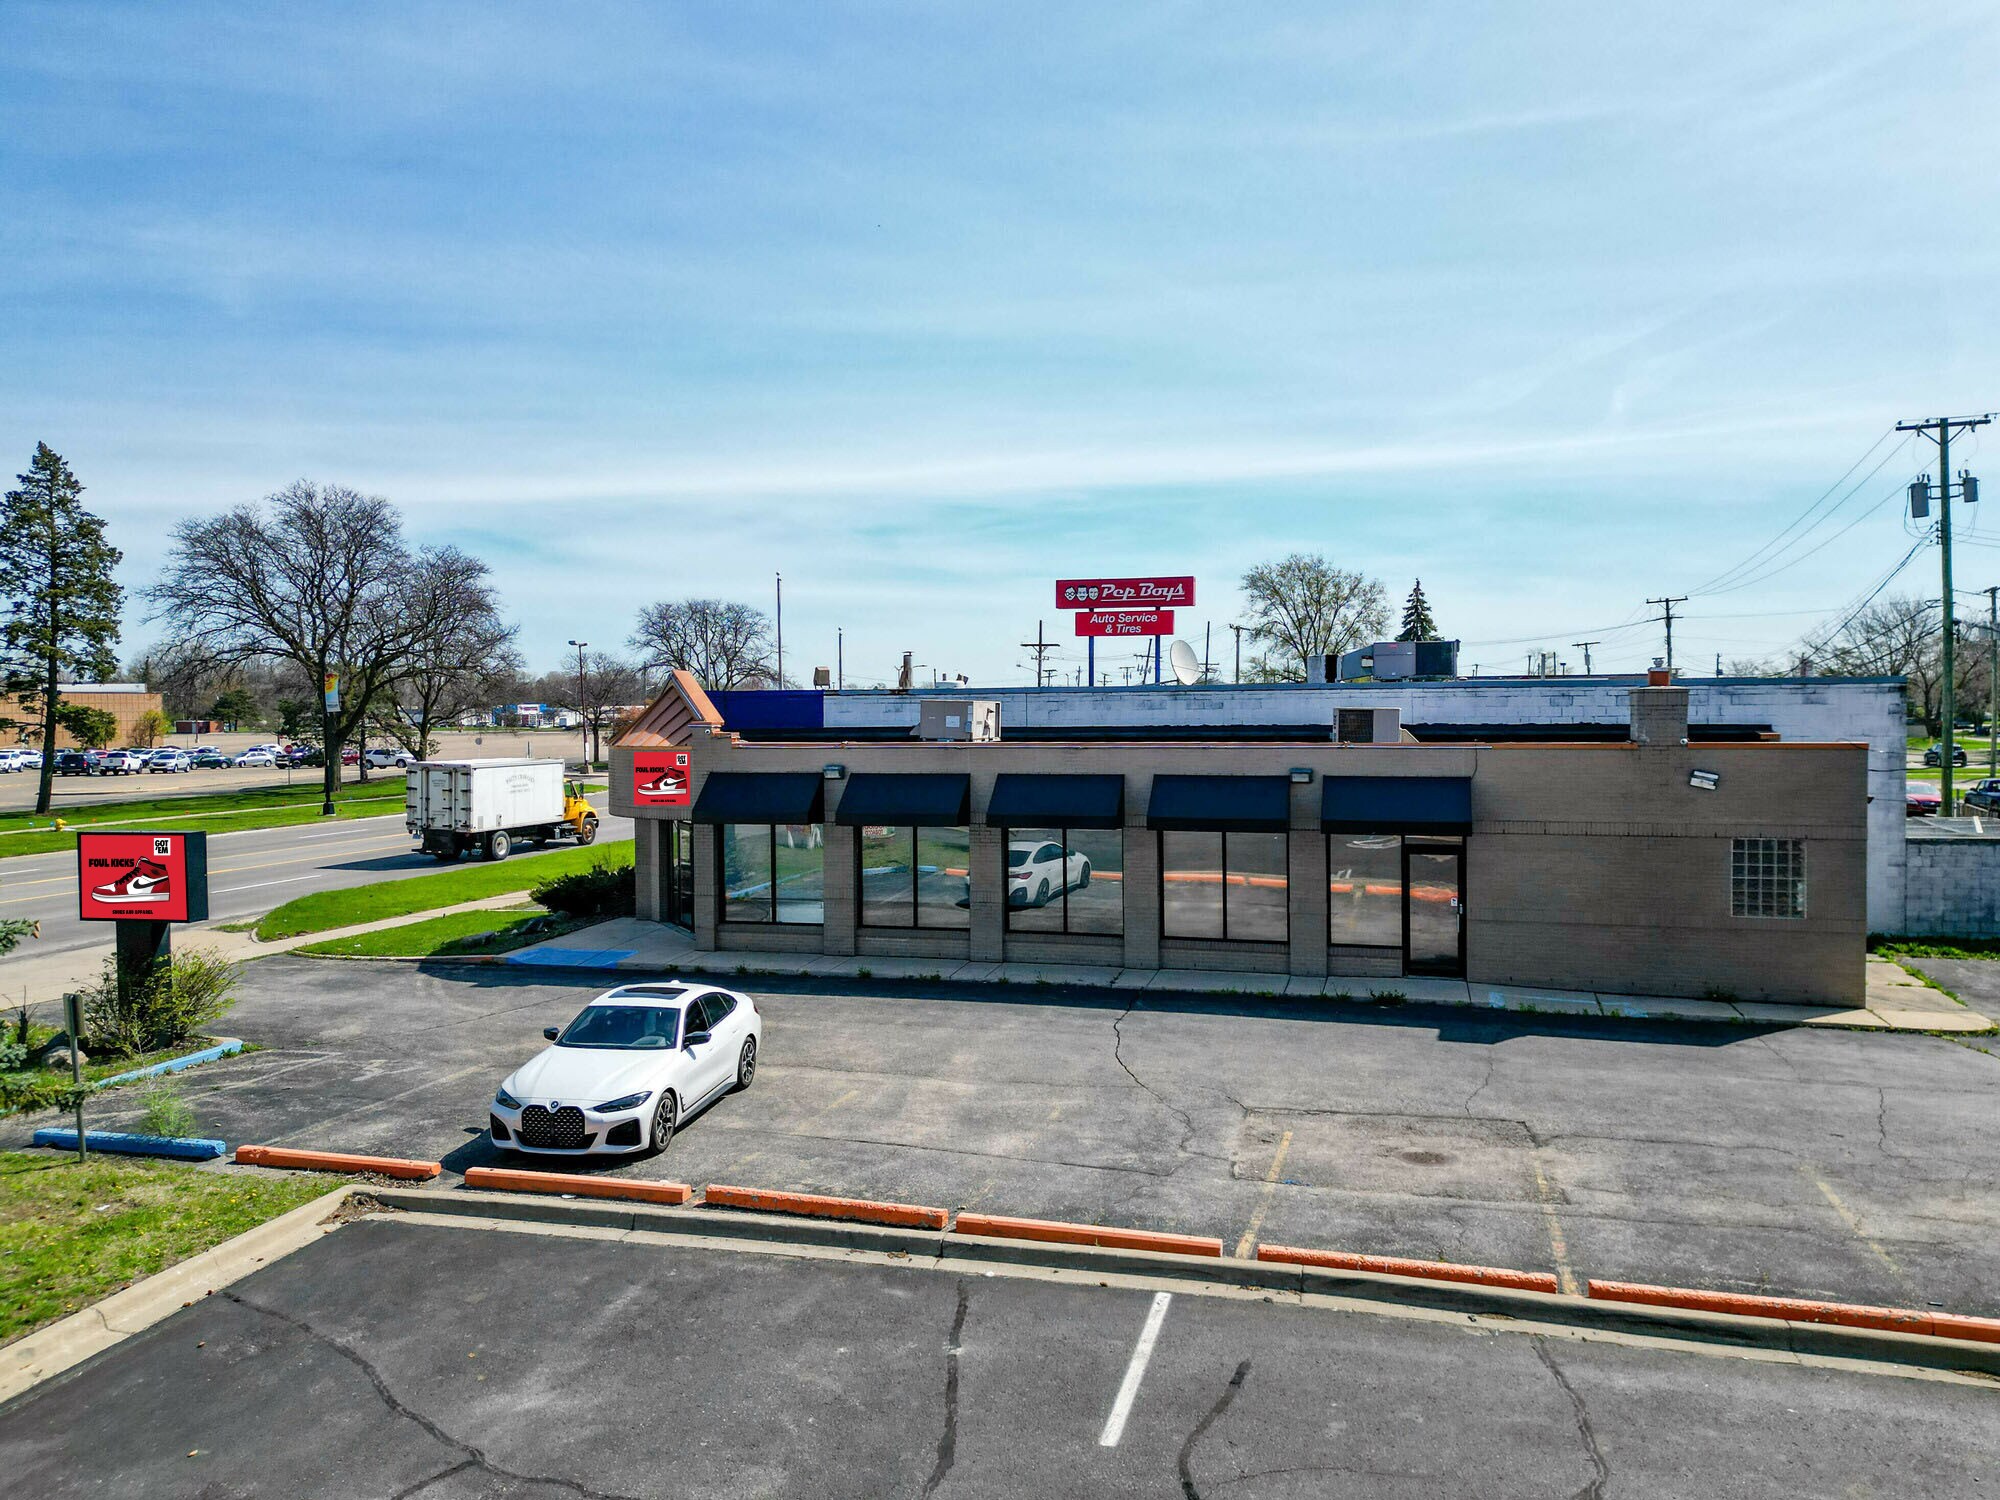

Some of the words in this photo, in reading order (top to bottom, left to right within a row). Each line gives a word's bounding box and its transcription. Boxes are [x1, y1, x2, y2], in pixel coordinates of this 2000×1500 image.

[1101, 584, 1136, 600] Pep
[1139, 582, 1185, 601] Boys
[1090, 614, 1115, 623] Auto
[1118, 613, 1158, 623] Service
[1105, 624, 1113, 634] &
[1116, 624, 1142, 633] Tires
[154, 839, 169, 847] GOT
[88, 858, 110, 867] FOUL
[111, 858, 135, 867] KICKS
